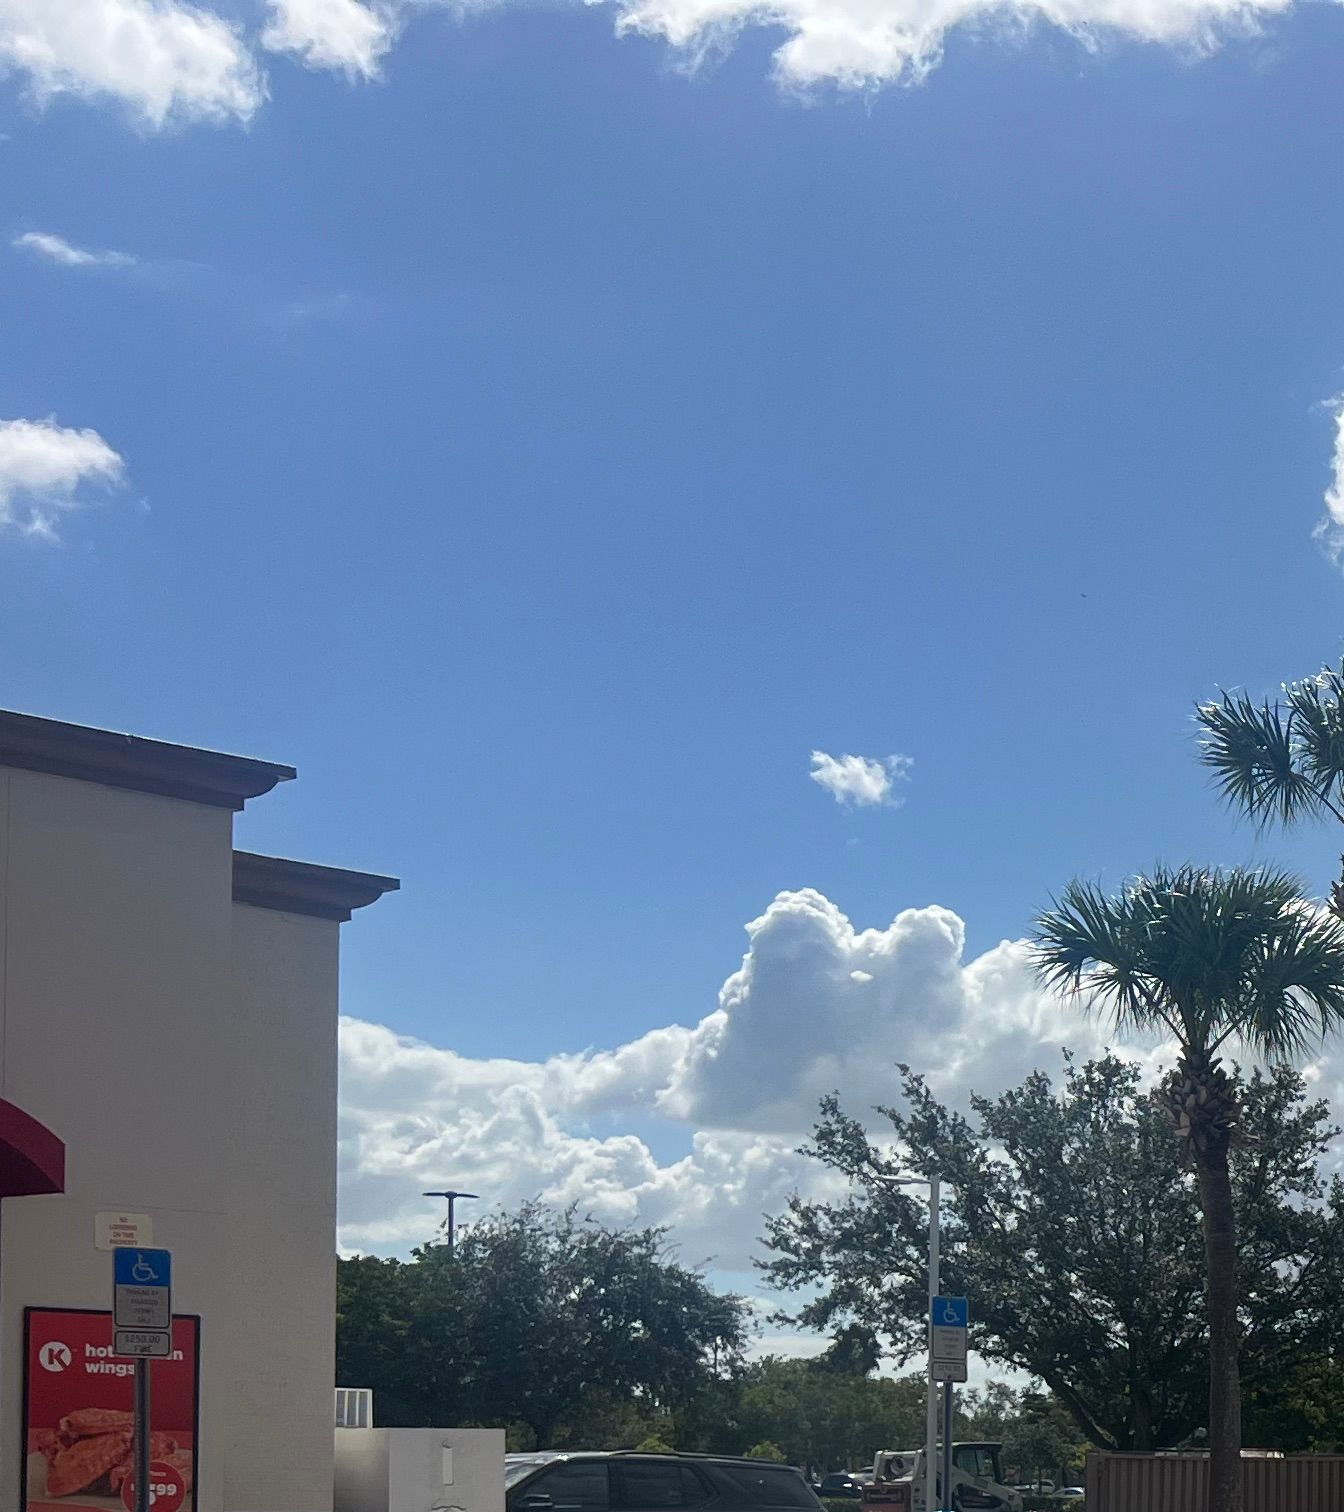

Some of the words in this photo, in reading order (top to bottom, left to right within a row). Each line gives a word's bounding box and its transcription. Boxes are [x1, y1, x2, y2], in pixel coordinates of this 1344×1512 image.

[39, 1341, 72, 1372] K
[85, 1344, 114, 1358] hot
[85, 1361, 134, 1377] wings
